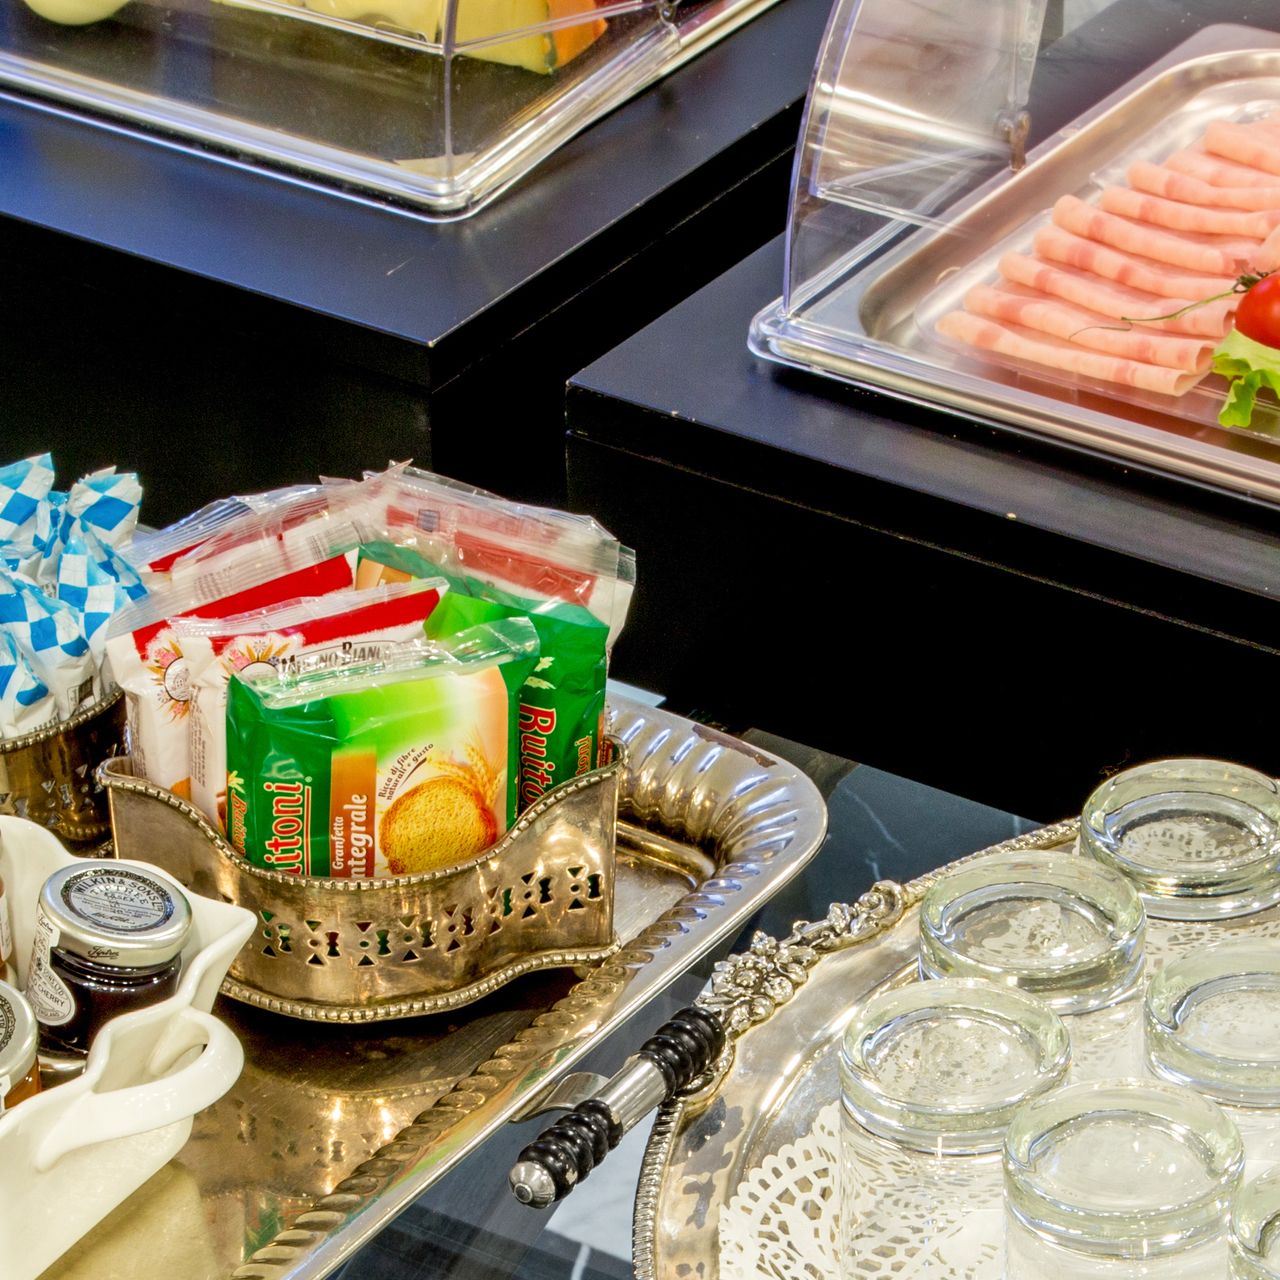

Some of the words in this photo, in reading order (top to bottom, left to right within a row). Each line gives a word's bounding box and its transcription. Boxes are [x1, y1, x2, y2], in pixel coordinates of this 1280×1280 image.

[412, 743, 434, 763] gusto
[332, 815, 344, 870] Granfetta
[343, 793, 374, 879] ntegrale
[74, 877, 115, 894] WILKIN
[128, 882, 159, 900] SONS
[90, 885, 149, 905] TIPTREE
